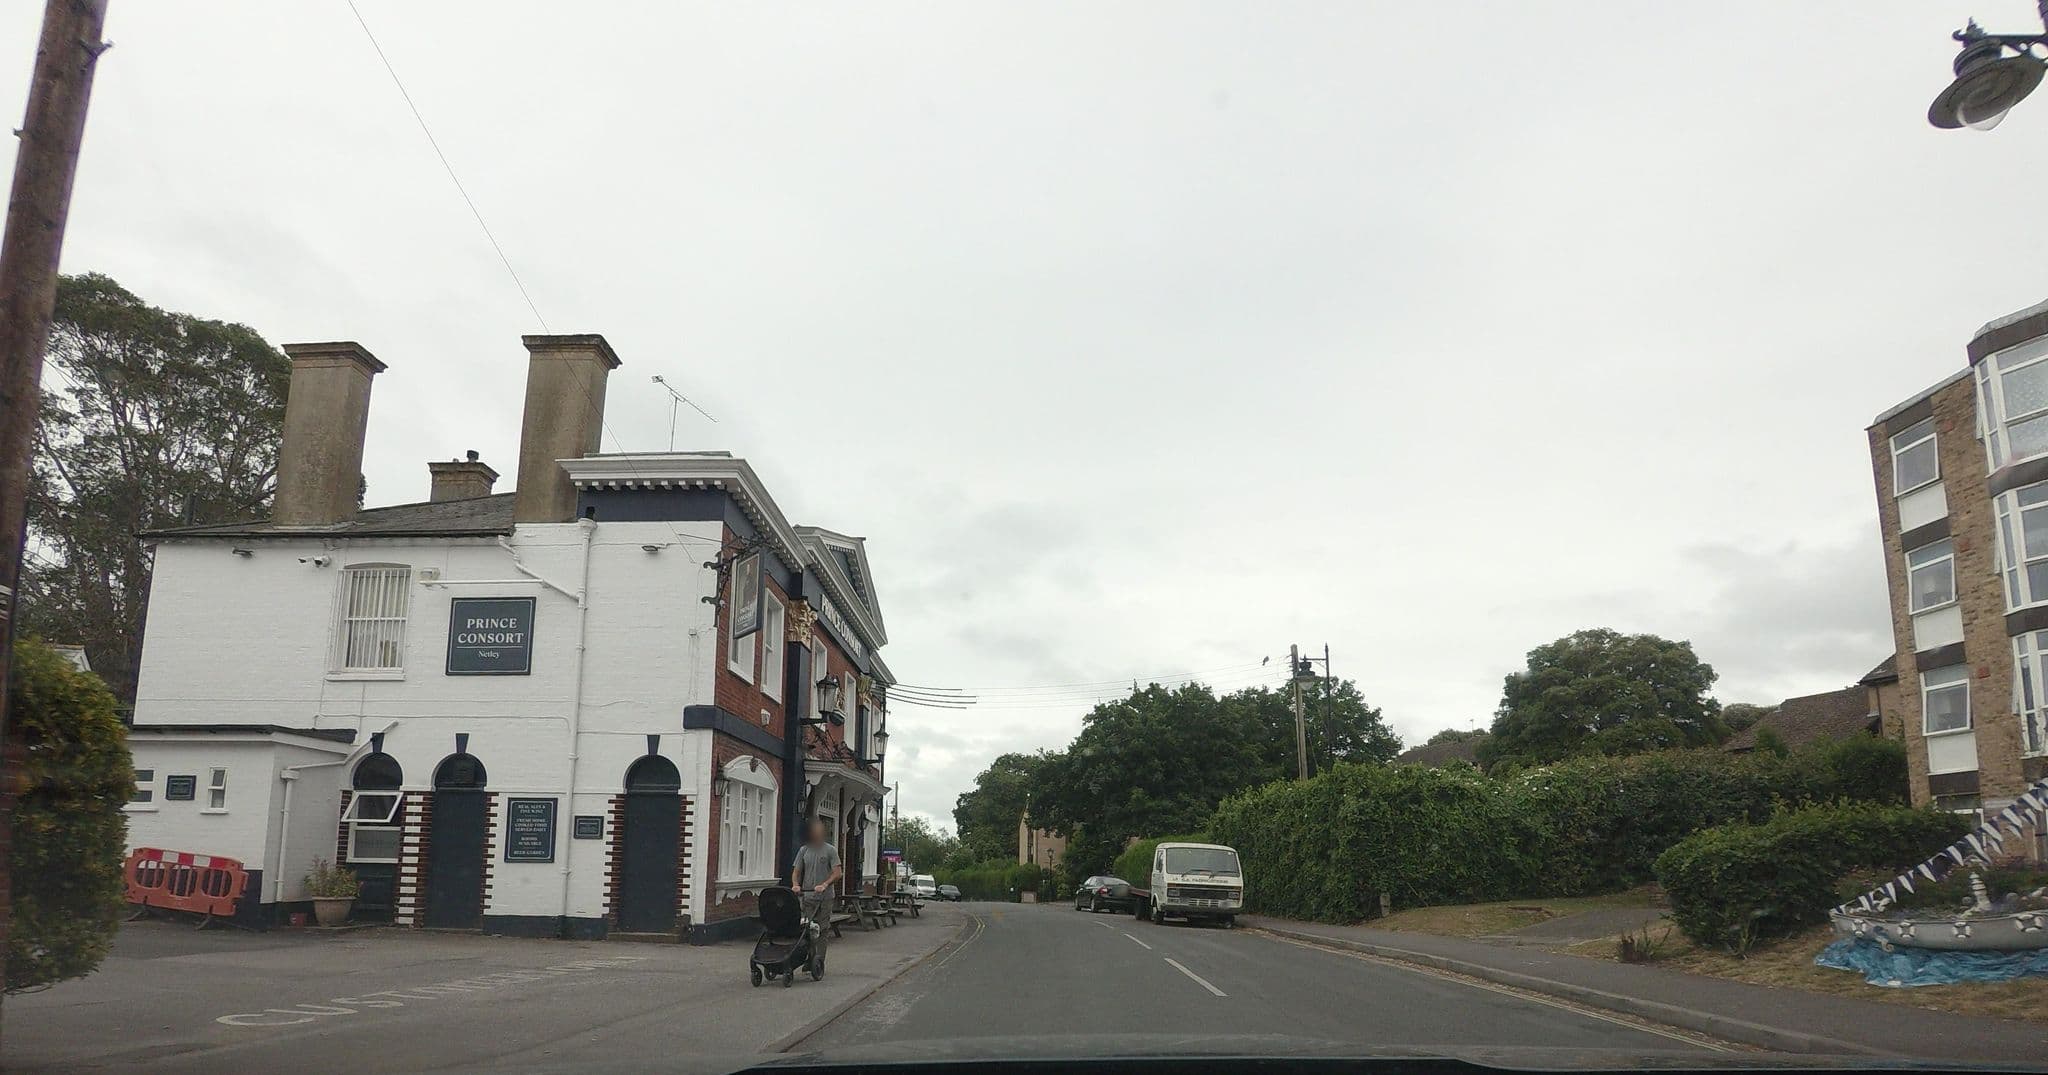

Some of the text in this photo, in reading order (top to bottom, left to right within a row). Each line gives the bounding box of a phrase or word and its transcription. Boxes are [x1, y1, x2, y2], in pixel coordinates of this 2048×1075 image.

[466, 618, 517, 629] PRINCE
[457, 633, 524, 644] CONSORT
[478, 650, 499, 659] Netley
